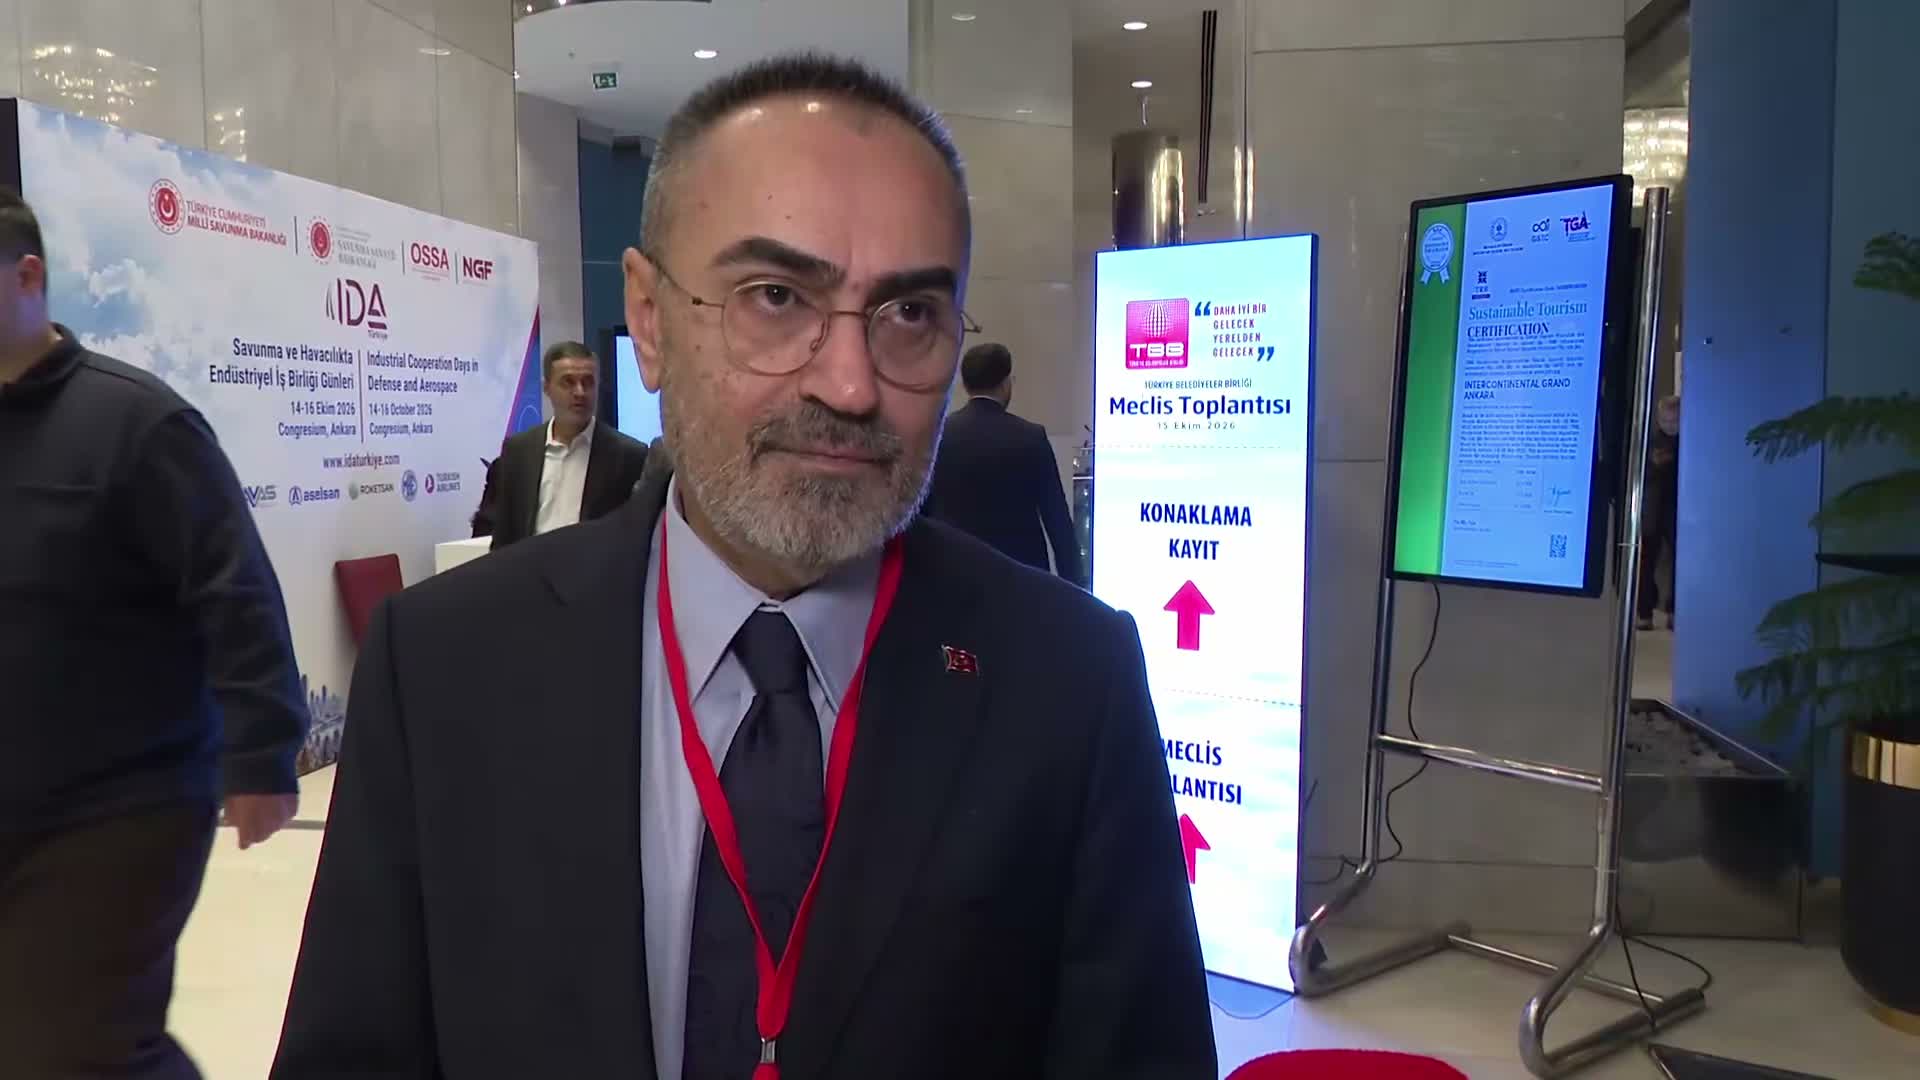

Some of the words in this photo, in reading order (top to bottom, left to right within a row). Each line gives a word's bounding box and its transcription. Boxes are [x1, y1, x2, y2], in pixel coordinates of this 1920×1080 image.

[210, 220, 249, 239] SAVUNMA
[1560, 211, 1591, 236] TGA
[411, 242, 449, 270] OSSA
[463, 256, 493, 280] NGF
[1214, 305, 1235, 316] DAHA
[1238, 303, 1250, 315] İYİ
[1252, 302, 1267, 314] BİR
[1469, 301, 1533, 321] Sustainable
[1538, 299, 1588, 317] Tourism
[1213, 319, 1255, 330] GELECEK
[1467, 322, 1550, 339] CERTIFICATION
[1213, 332, 1261, 344] YERELDEN
[233, 338, 283, 359] Savunma
[285, 346, 298, 360] ve
[300, 344, 353, 364] Havacılıkta
[1213, 346, 1254, 357] GELECEK
[367, 350, 406, 368] Industrial
[408, 353, 453, 373] Cooperation
[454, 356, 471, 375] Days
[472, 358, 479, 372] in
[209, 364, 273, 390] Endüstriyel
[276, 364, 286, 391] İş
[288, 369, 319, 392] Birliği
[321, 370, 354, 389] Günleri
[368, 374, 402, 392] Defense
[404, 377, 418, 392] and
[420, 378, 458, 396] Aerospace
[1144, 379, 1173, 390] TÜRKİYE
[1175, 378, 1223, 390] BELEDİYELER
[1464, 379, 1540, 389] INTERCONTINENTAL
[1541, 377, 1571, 388] GRAND
[1463, 391, 1496, 400] ANKARA
[290, 401, 315, 416] 14-16
[316, 401, 336, 415] Ekim
[337, 401, 356, 416] 2026
[390, 402, 416, 416] October
[1110, 396, 1173, 415] Meclis
[1178, 395, 1291, 419] Toplantısı
[279, 422, 329, 439] Congresium,
[330, 422, 356, 436] Ankara
[412, 422, 433, 435] Ankara
[1157, 421, 1168, 430] 15
[1174, 420, 1201, 430] Ekim
[1207, 421, 1236, 430] 2026
[323, 453, 400, 470] www.idaturkiye.com
[304, 486, 340, 501] aselsan
[361, 484, 394, 494] ROKETSAN
[1140, 502, 1252, 527] KONAKLAMA
[1169, 538, 1220, 560] KAYIT
[1172, 774, 1242, 805] LANTISI
